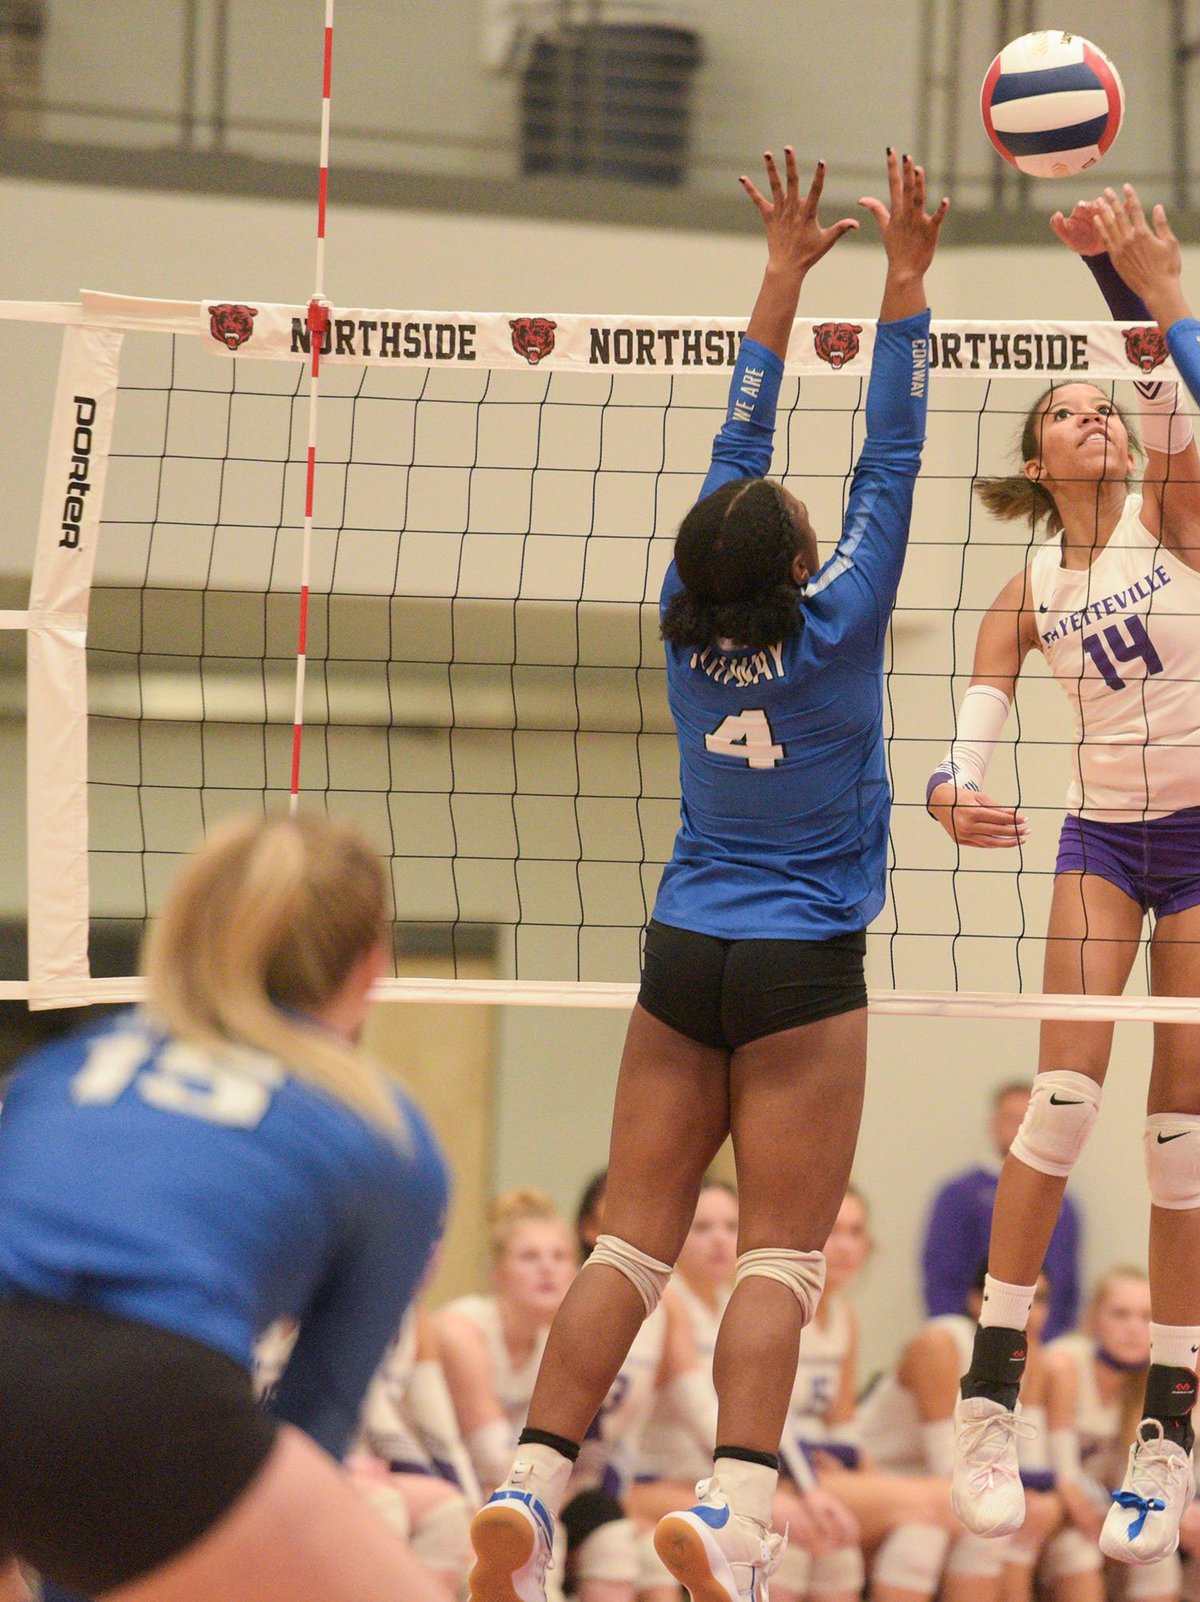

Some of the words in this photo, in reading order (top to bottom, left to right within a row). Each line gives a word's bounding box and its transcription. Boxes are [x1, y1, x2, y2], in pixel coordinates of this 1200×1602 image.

[589, 328, 748, 366] NORTHSI
[929, 333, 1089, 370] RTHSIDE
[910, 338, 927, 399] CONWAY
[740, 366, 765, 398] ARE
[733, 399, 755, 422] WE
[1083, 614, 1164, 691] 14
[704, 709, 785, 768] 4
